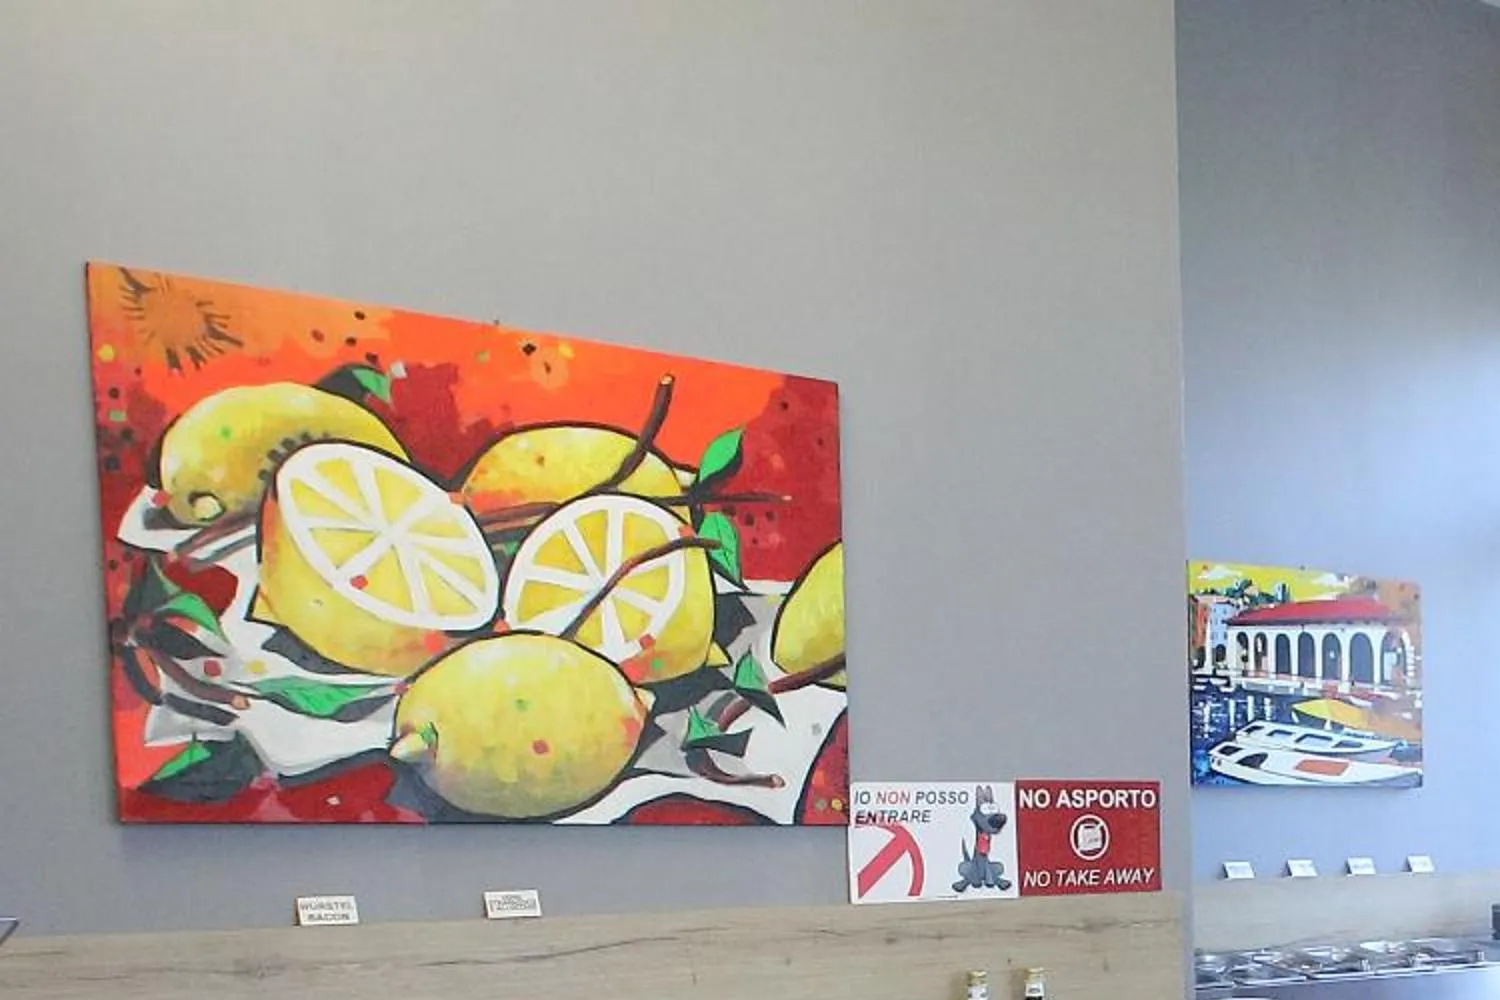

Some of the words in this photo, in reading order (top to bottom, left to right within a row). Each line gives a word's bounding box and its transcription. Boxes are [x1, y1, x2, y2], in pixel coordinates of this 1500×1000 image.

[854, 790, 871, 805] IO
[876, 791, 911, 805] NON
[915, 791, 969, 805] POSSO
[1019, 788, 1051, 809] NO
[1055, 788, 1156, 809] ASPORTO
[855, 809, 931, 825] ENTRARE
[1023, 870, 1051, 888] NO
[1055, 869, 1101, 886] TAKE
[1103, 867, 1155, 885] AWAY
